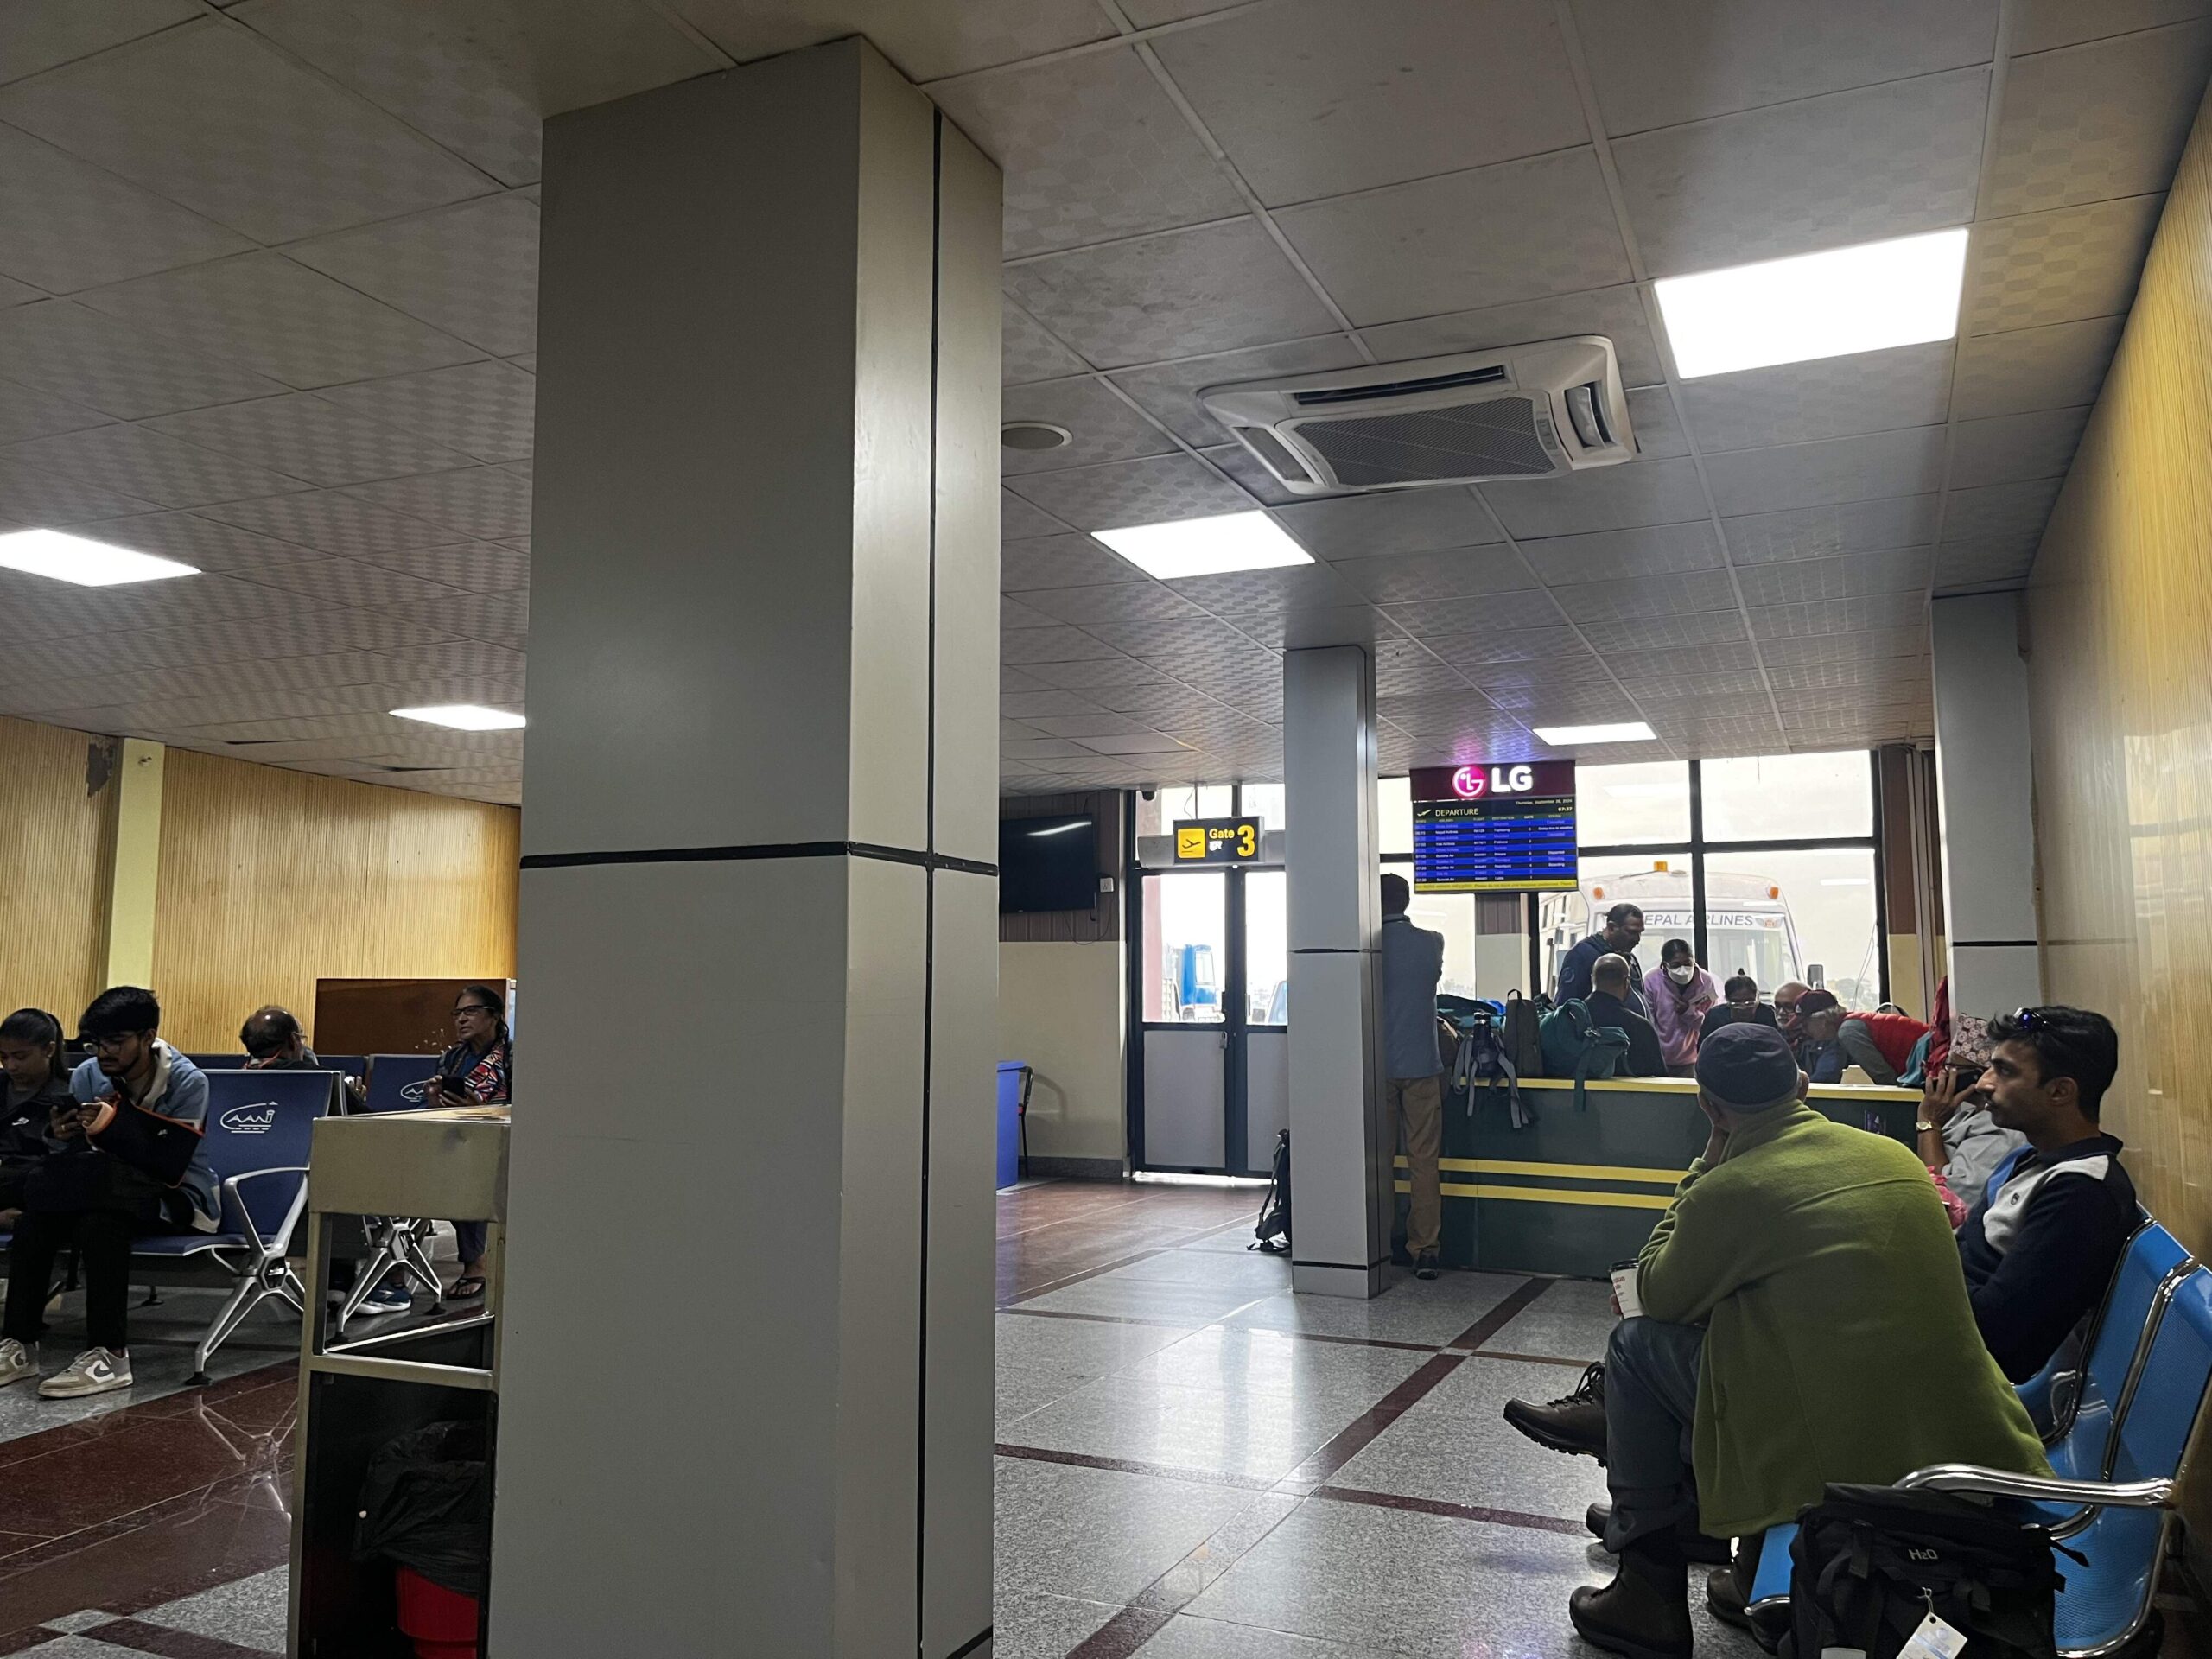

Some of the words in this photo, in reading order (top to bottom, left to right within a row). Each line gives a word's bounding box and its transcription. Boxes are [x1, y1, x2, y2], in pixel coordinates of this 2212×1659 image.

[1491, 766, 1534, 792] LG
[1435, 808, 1479, 817] DEPARTURE
[1209, 828, 1235, 839] Gate
[1236, 824, 1255, 857] 3
[1644, 914, 1681, 925] EPAL
[1908, 1548, 1938, 1560] H2O
